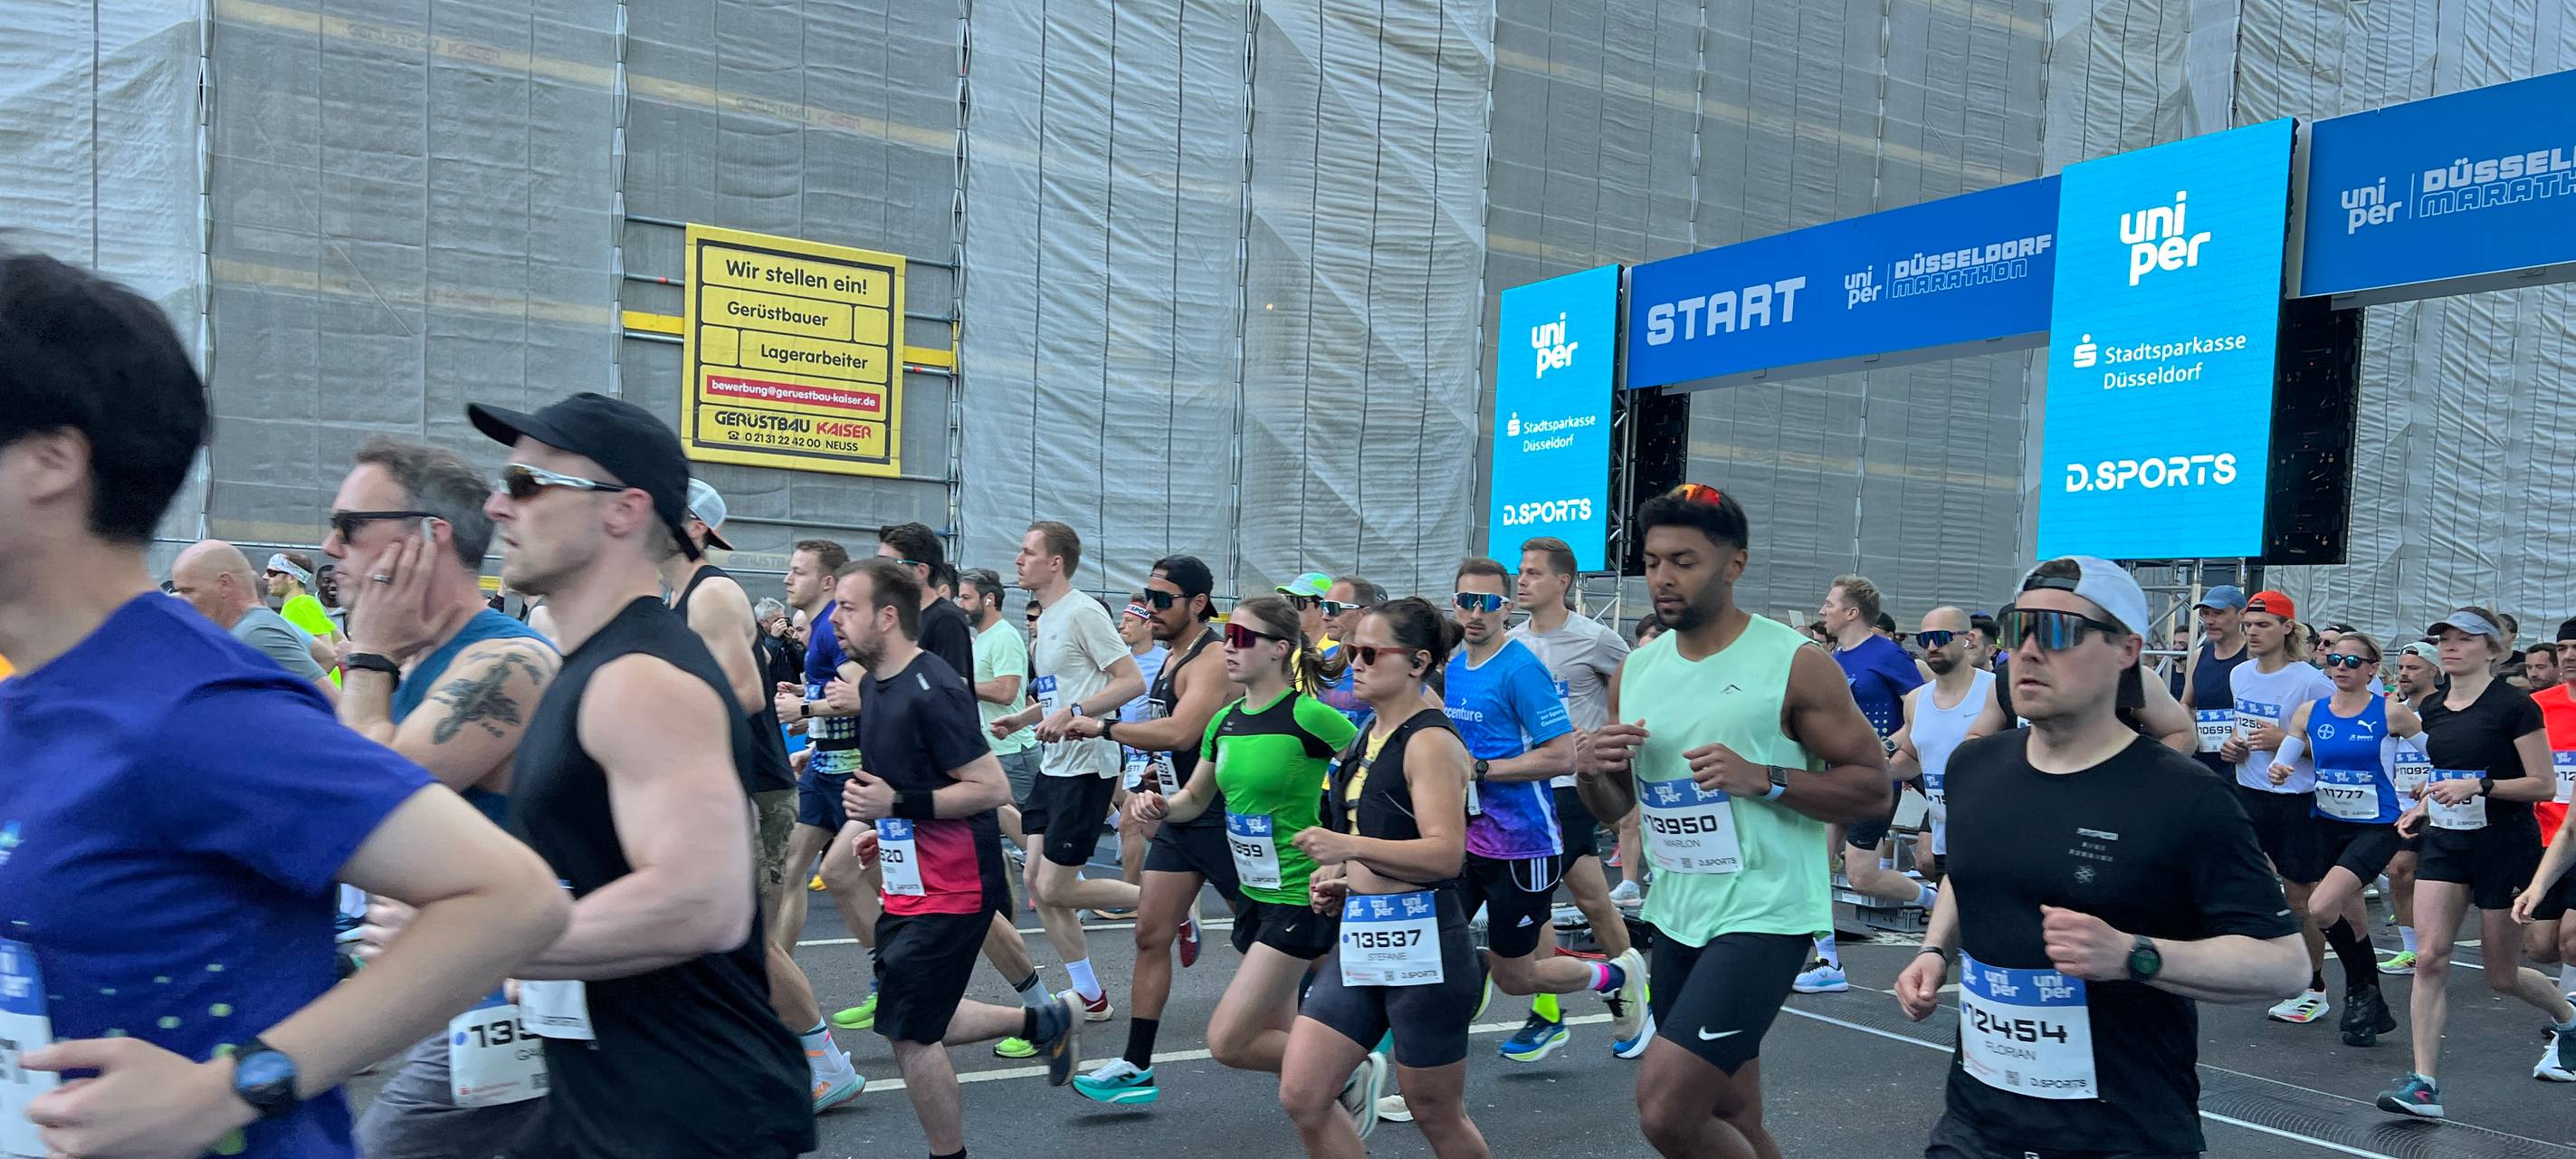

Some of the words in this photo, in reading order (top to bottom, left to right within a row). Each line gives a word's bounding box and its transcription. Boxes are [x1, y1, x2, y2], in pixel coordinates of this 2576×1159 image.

[2422, 145, 2576, 193] DÜSSEL
[2341, 177, 2387, 210] uni
[2119, 189, 2188, 245] uni
[2348, 200, 2403, 235] per
[1894, 233, 2053, 279] DÜSSELDORF
[2129, 230, 2211, 287] per
[725, 259, 760, 280] Wir
[765, 266, 828, 289] stellen
[833, 275, 868, 295] ein!
[1844, 263, 1874, 291] uni
[1892, 257, 2028, 299] MARATHON
[1646, 275, 1807, 347] START
[1847, 283, 1883, 311] per
[727, 301, 829, 327] Gerüstbauer
[1531, 311, 1567, 350] uni
[760, 343, 869, 370] Lagerarbeiter
[1535, 340, 1579, 379] per
[2104, 333, 2247, 365] Stadtsparkasse
[2103, 362, 2203, 390] Düsseldorf
[711, 379, 876, 407] bewerbung@geruestbau-kaiser.de
[714, 410, 811, 434] GERÜSTBAU
[816, 420, 873, 439] KAISER
[1523, 414, 1597, 435] Stadtsparkasse
[825, 440, 859, 452] NEUSS
[1522, 433, 1575, 453] Düsseldorf
[2065, 452, 2237, 493] D.SPORTS
[1503, 498, 1592, 527] D.SPORTS
[2199, 725, 2233, 735] 10699
[2399, 767, 2430, 775] 11092
[1659, 792, 1683, 806] per
[2323, 788, 2364, 799] 11777
[1351, 929, 1422, 949] 13537
[1984, 970, 2008, 985] uni
[1990, 982, 2020, 997] per
[2032, 971, 2065, 988] uni
[2039, 985, 2076, 1002] per
[1967, 1002, 2068, 1044] 12454
[1985, 1040, 2037, 1061] FLORIAN
